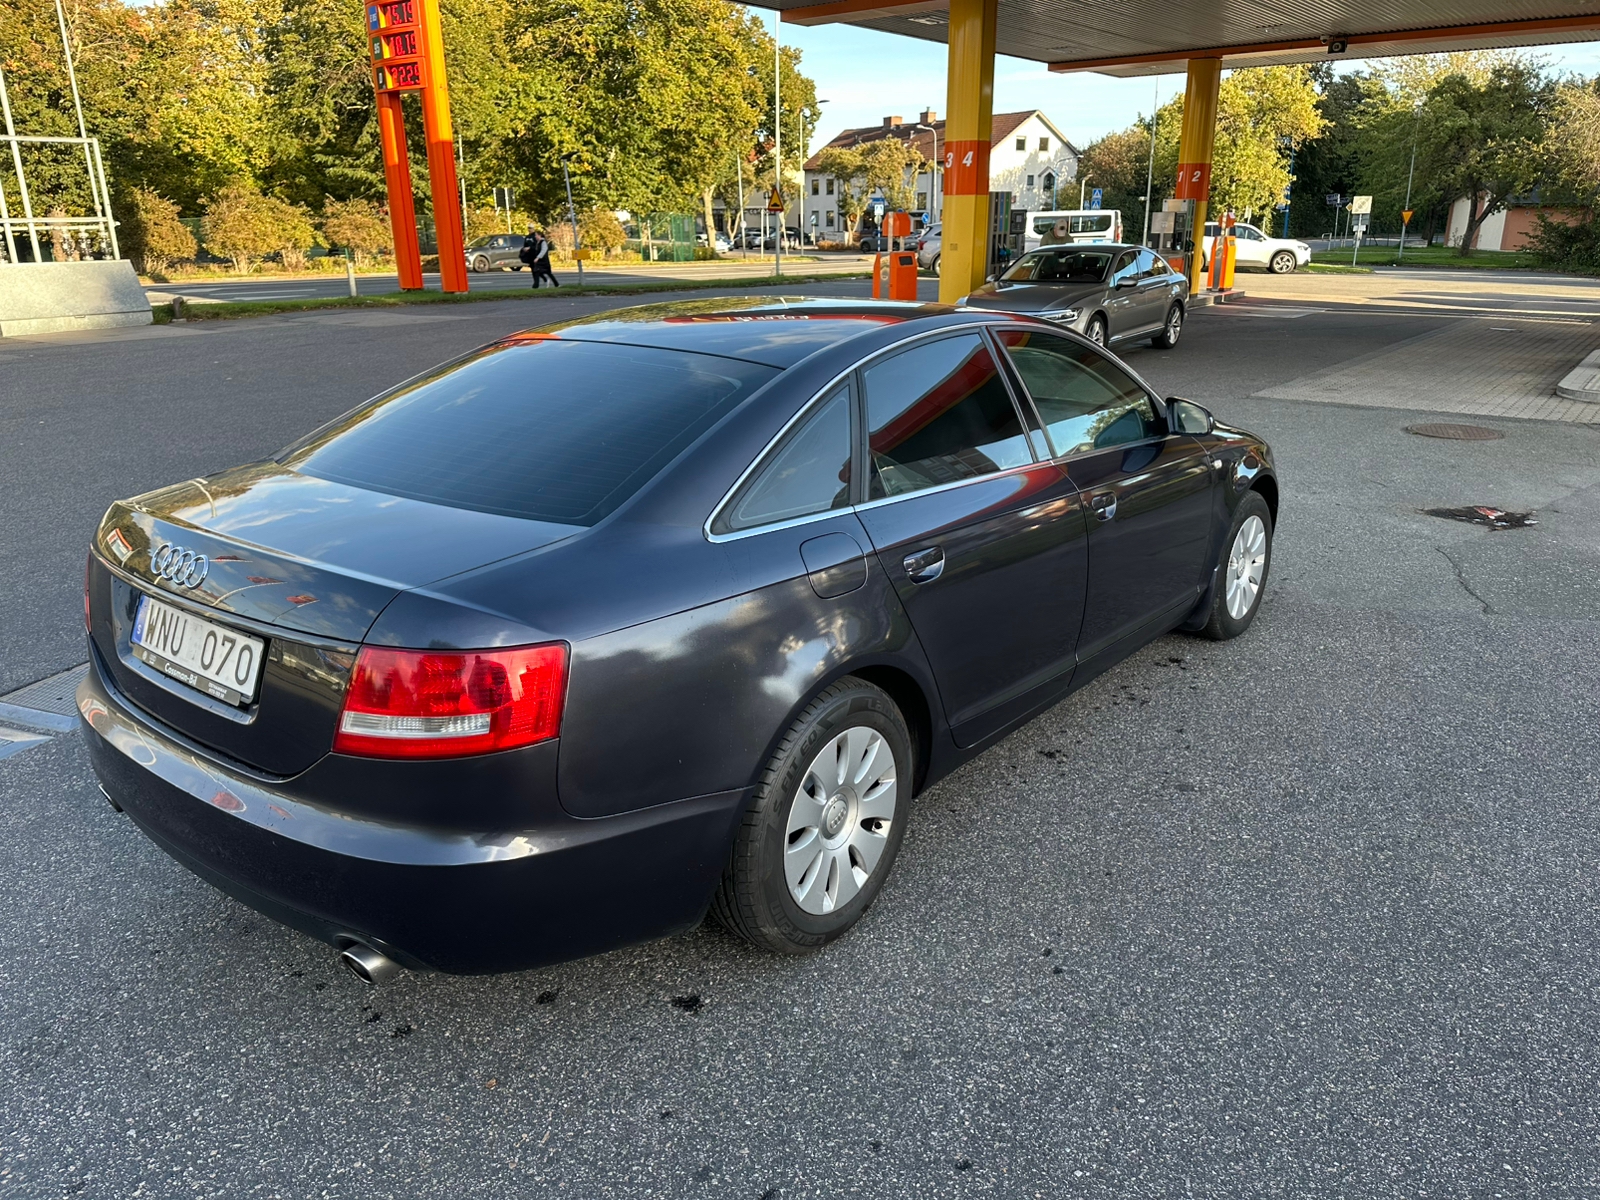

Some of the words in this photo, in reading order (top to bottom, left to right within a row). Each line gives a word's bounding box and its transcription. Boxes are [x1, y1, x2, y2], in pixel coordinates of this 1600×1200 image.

[373, 42, 381, 55] 95
[945, 152, 954, 169] 3
[962, 150, 974, 167] 4
[1178, 170, 1184, 182] 1
[1191, 170, 1202, 183] 2
[144, 603, 188, 657] WNU
[200, 629, 254, 686] 070
